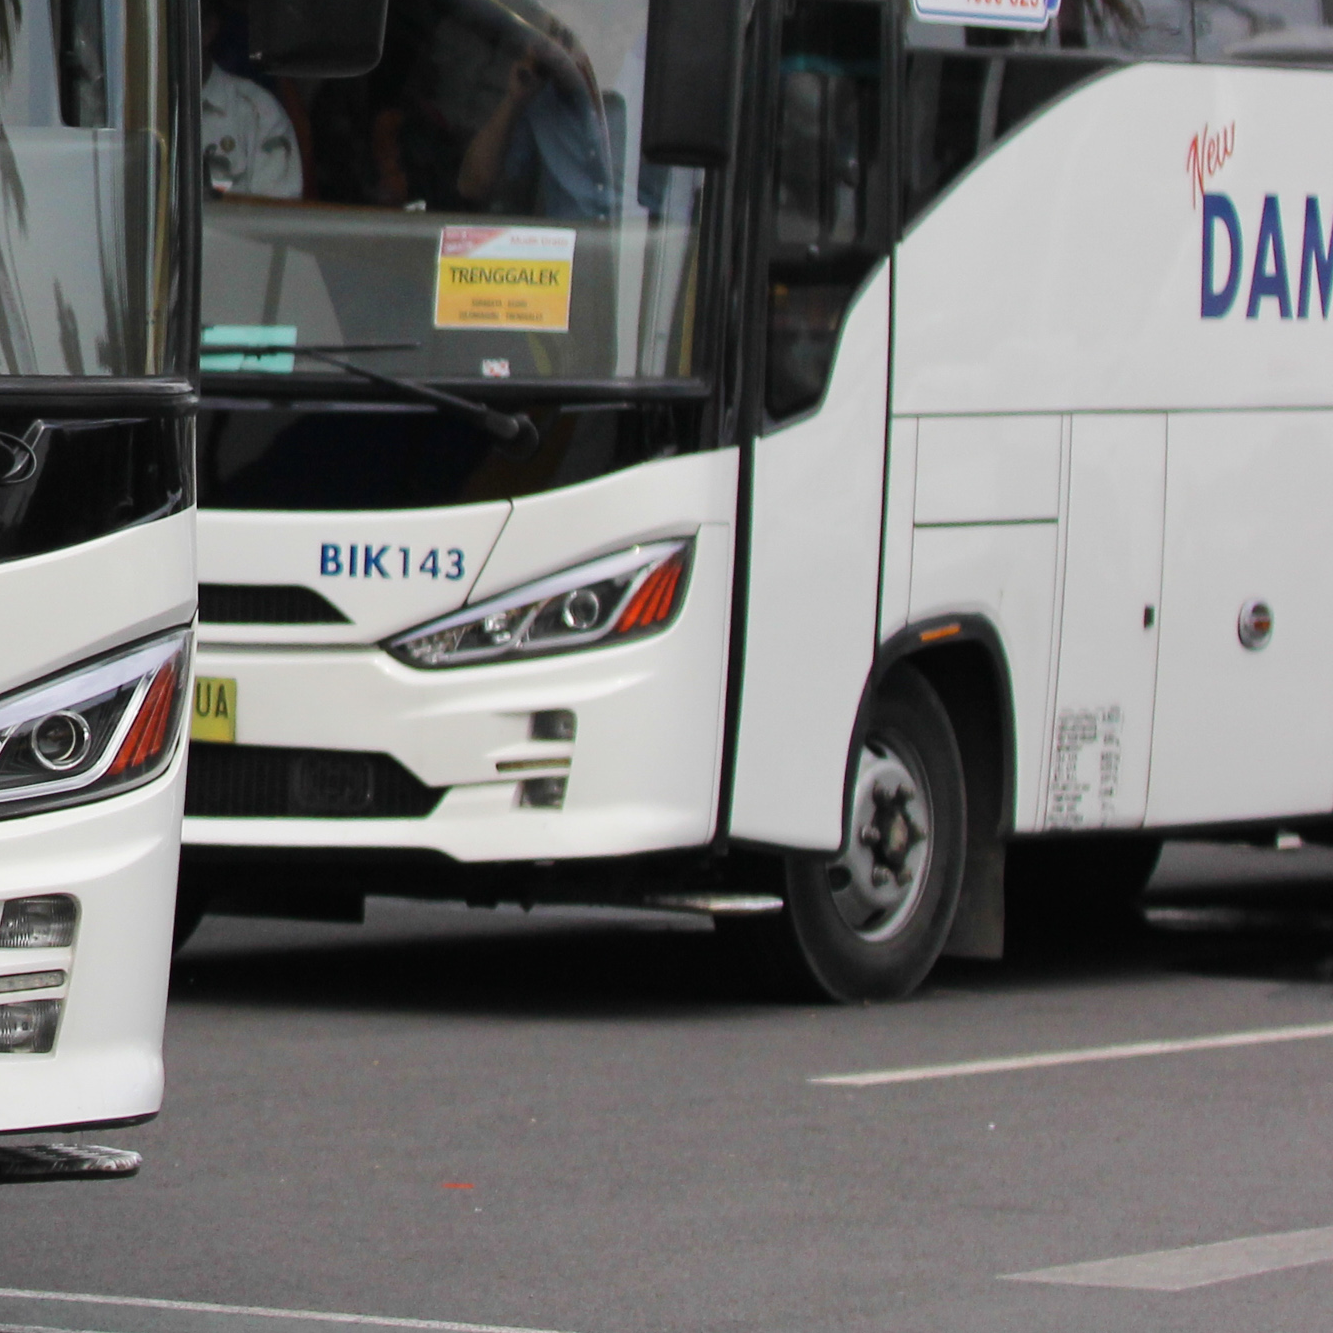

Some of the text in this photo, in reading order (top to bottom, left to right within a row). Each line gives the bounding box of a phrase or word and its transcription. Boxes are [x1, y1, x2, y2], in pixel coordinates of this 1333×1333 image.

[1186, 119, 1236, 210] New
[450, 267, 560, 286] TRENGGALEK
[320, 543, 466, 581] BIK143
[196, 682, 229, 718] UA
